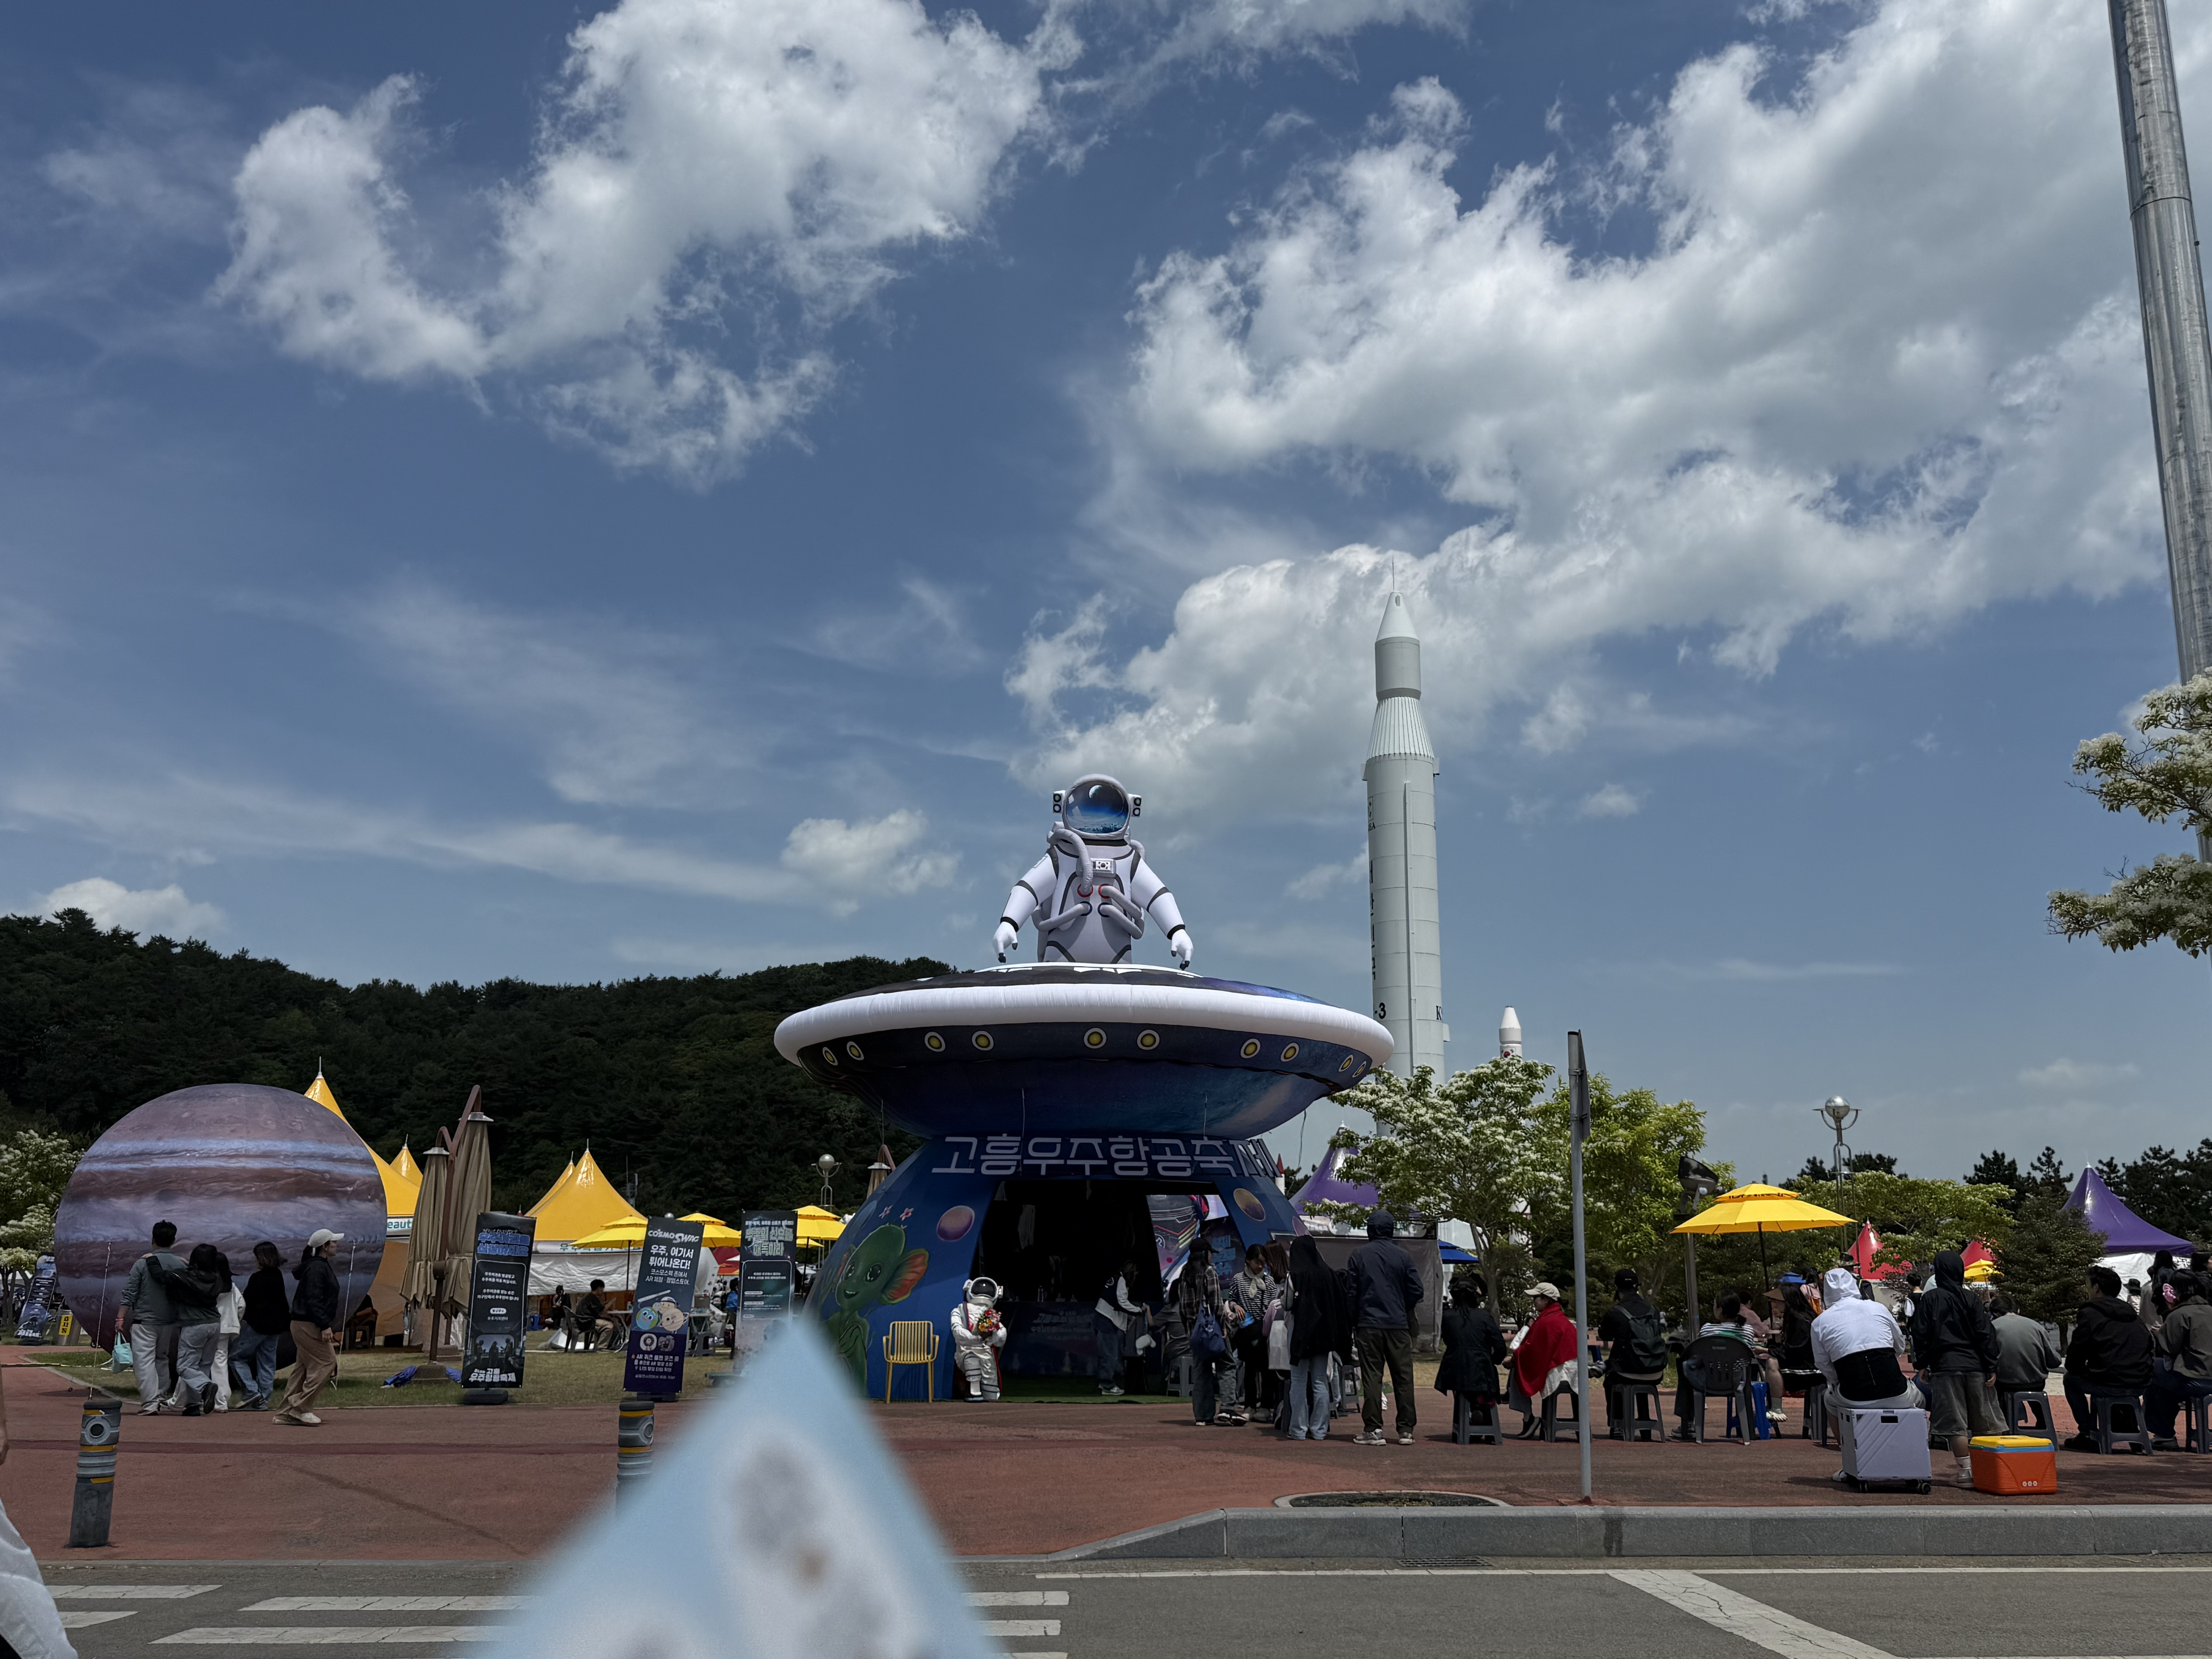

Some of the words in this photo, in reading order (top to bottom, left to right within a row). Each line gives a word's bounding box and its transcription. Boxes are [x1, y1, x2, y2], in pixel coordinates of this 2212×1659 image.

[1436, 1005, 1443, 1021] K
[931, 1133, 1283, 1178] 고흥우주항공축제
[387, 1219, 411, 1228] eaut
[650, 1245, 668, 1256] 우주,
[670, 1247, 694, 1258] 여기서
[649, 1256, 690, 1269] 튀어나온다!
